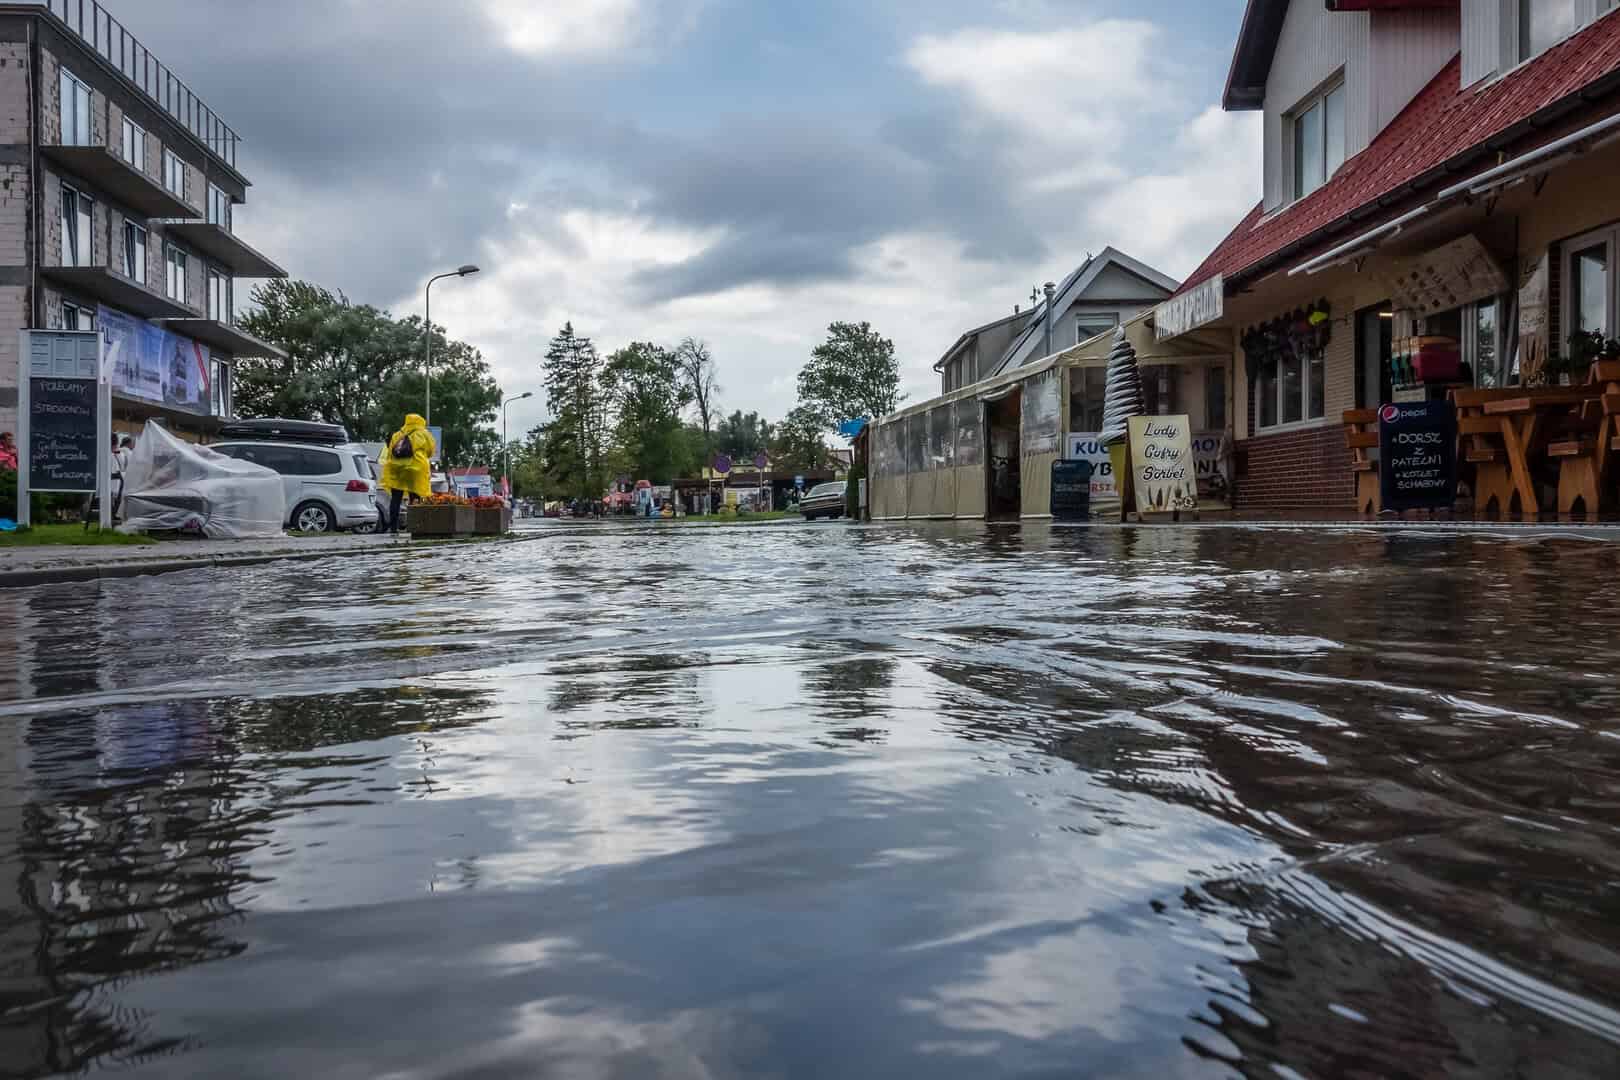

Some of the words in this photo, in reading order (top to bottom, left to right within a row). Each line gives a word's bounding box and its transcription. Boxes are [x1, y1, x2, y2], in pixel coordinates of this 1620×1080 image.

[1401, 408, 1427, 419] pepsi
[1143, 422, 1177, 438] Lody
[1399, 432, 1442, 443] DORSZ
[1144, 443, 1179, 460] Gofry
[1143, 466, 1185, 480] Sorbet
